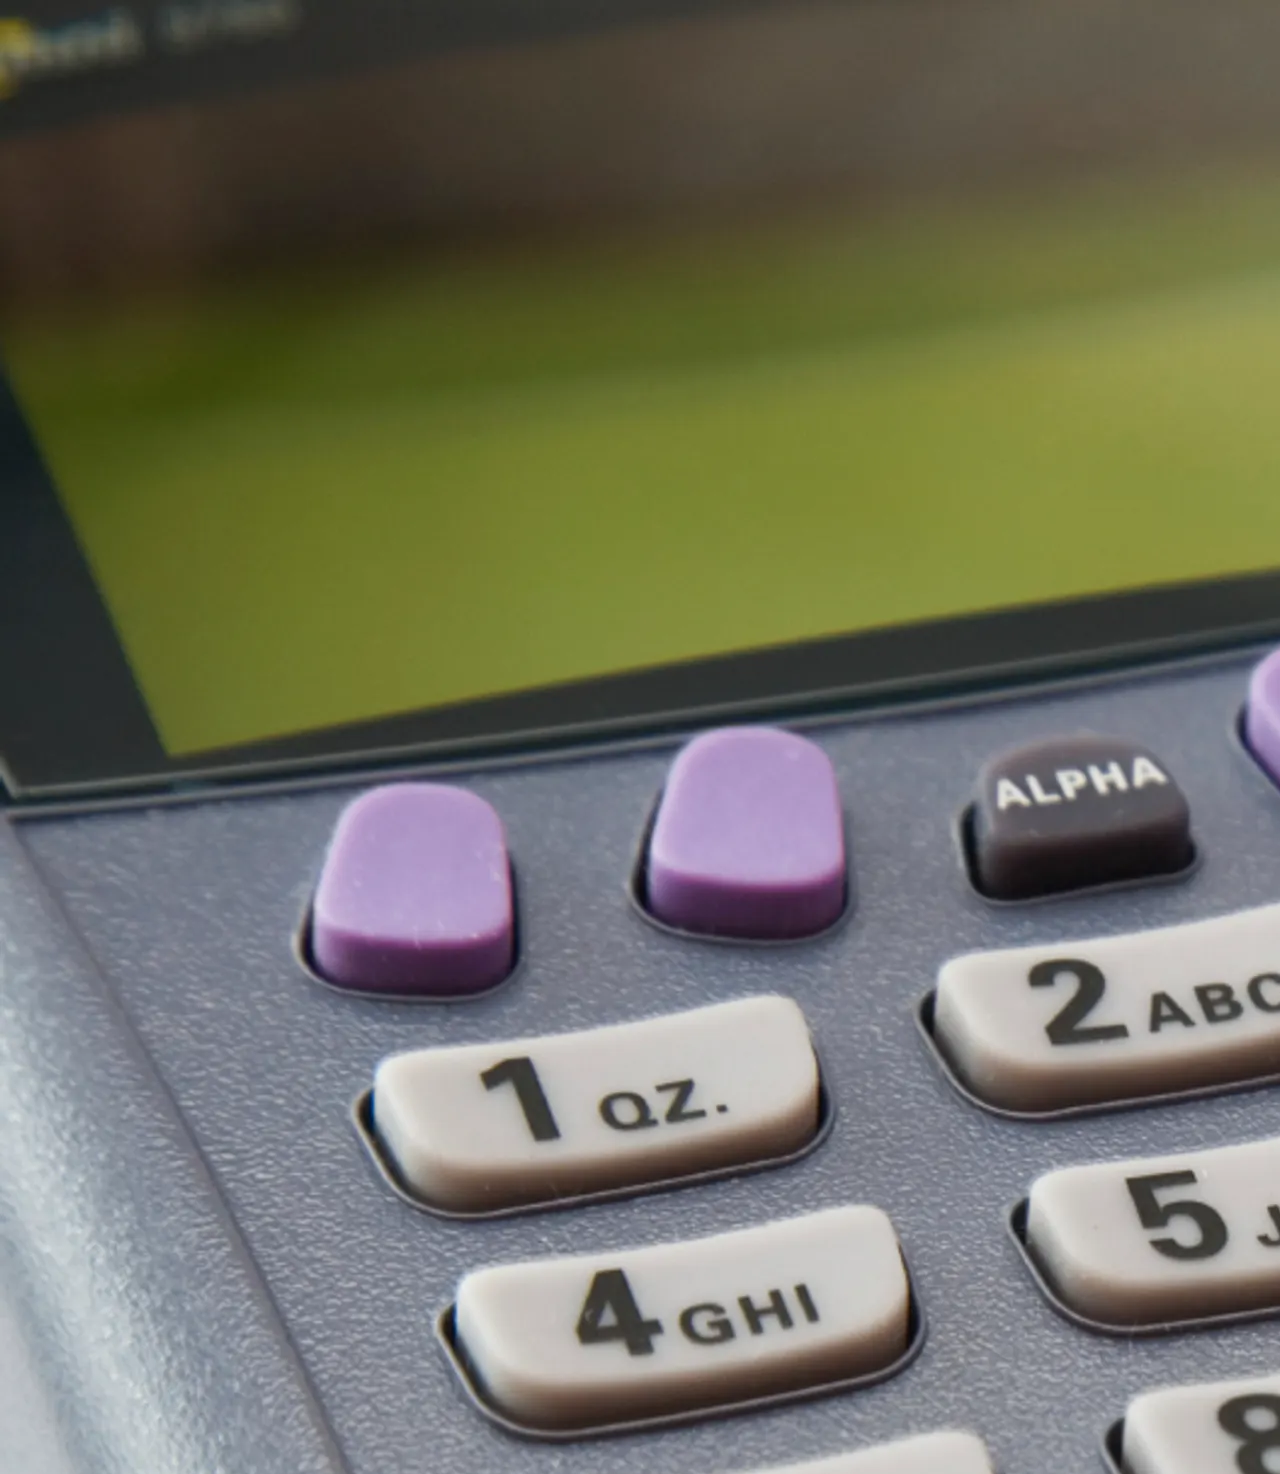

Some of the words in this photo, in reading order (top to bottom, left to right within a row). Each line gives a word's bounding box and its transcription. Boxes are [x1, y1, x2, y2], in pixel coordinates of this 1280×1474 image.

[996, 756, 1167, 809] ALPHA
[1028, 958, 1129, 1046] 2
[479, 1057, 561, 1142] 1
[599, 1078, 730, 1131] QZ.
[1125, 1169, 1228, 1260] 5
[575, 1268, 664, 1357] 4
[679, 1283, 820, 1345] GHI
